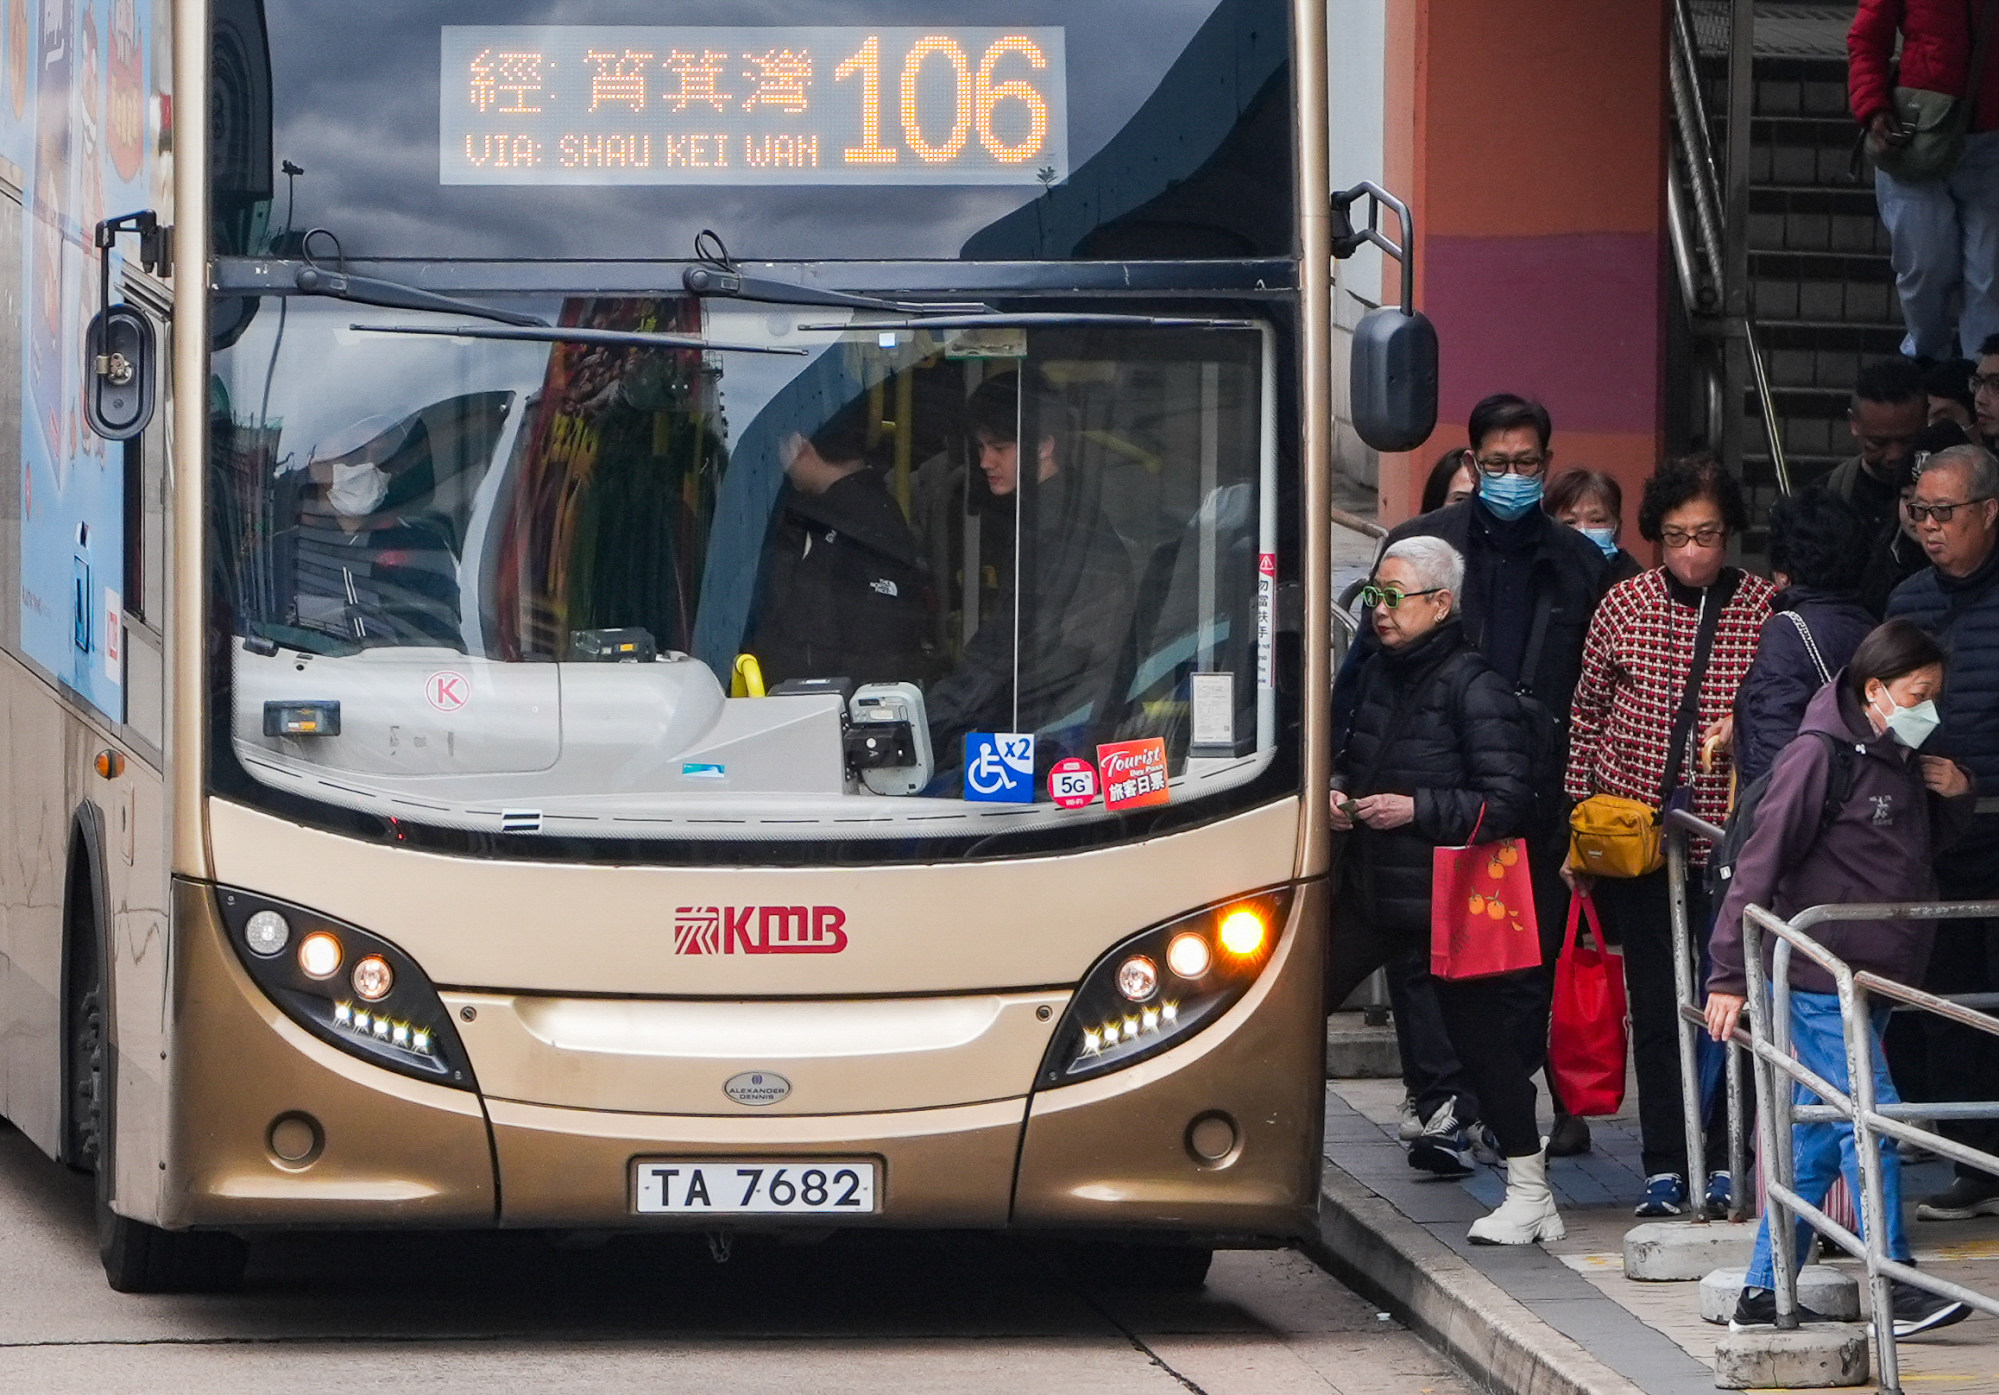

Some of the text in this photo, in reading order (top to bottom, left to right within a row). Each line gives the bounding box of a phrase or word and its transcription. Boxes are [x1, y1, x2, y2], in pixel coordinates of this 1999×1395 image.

[582, 48, 813, 113] 筲箕灣
[833, 35, 1050, 163] 106
[465, 134, 819, 168] VIA: SHAU KEI WAN
[438, 678, 461, 704] K
[1101, 746, 1161, 778] Tourist
[1061, 776, 1086, 794] 5G
[1109, 770, 1165, 802] 旅客日票
[724, 906, 848, 954] KMB
[651, 1169, 861, 1206] TA 7682
